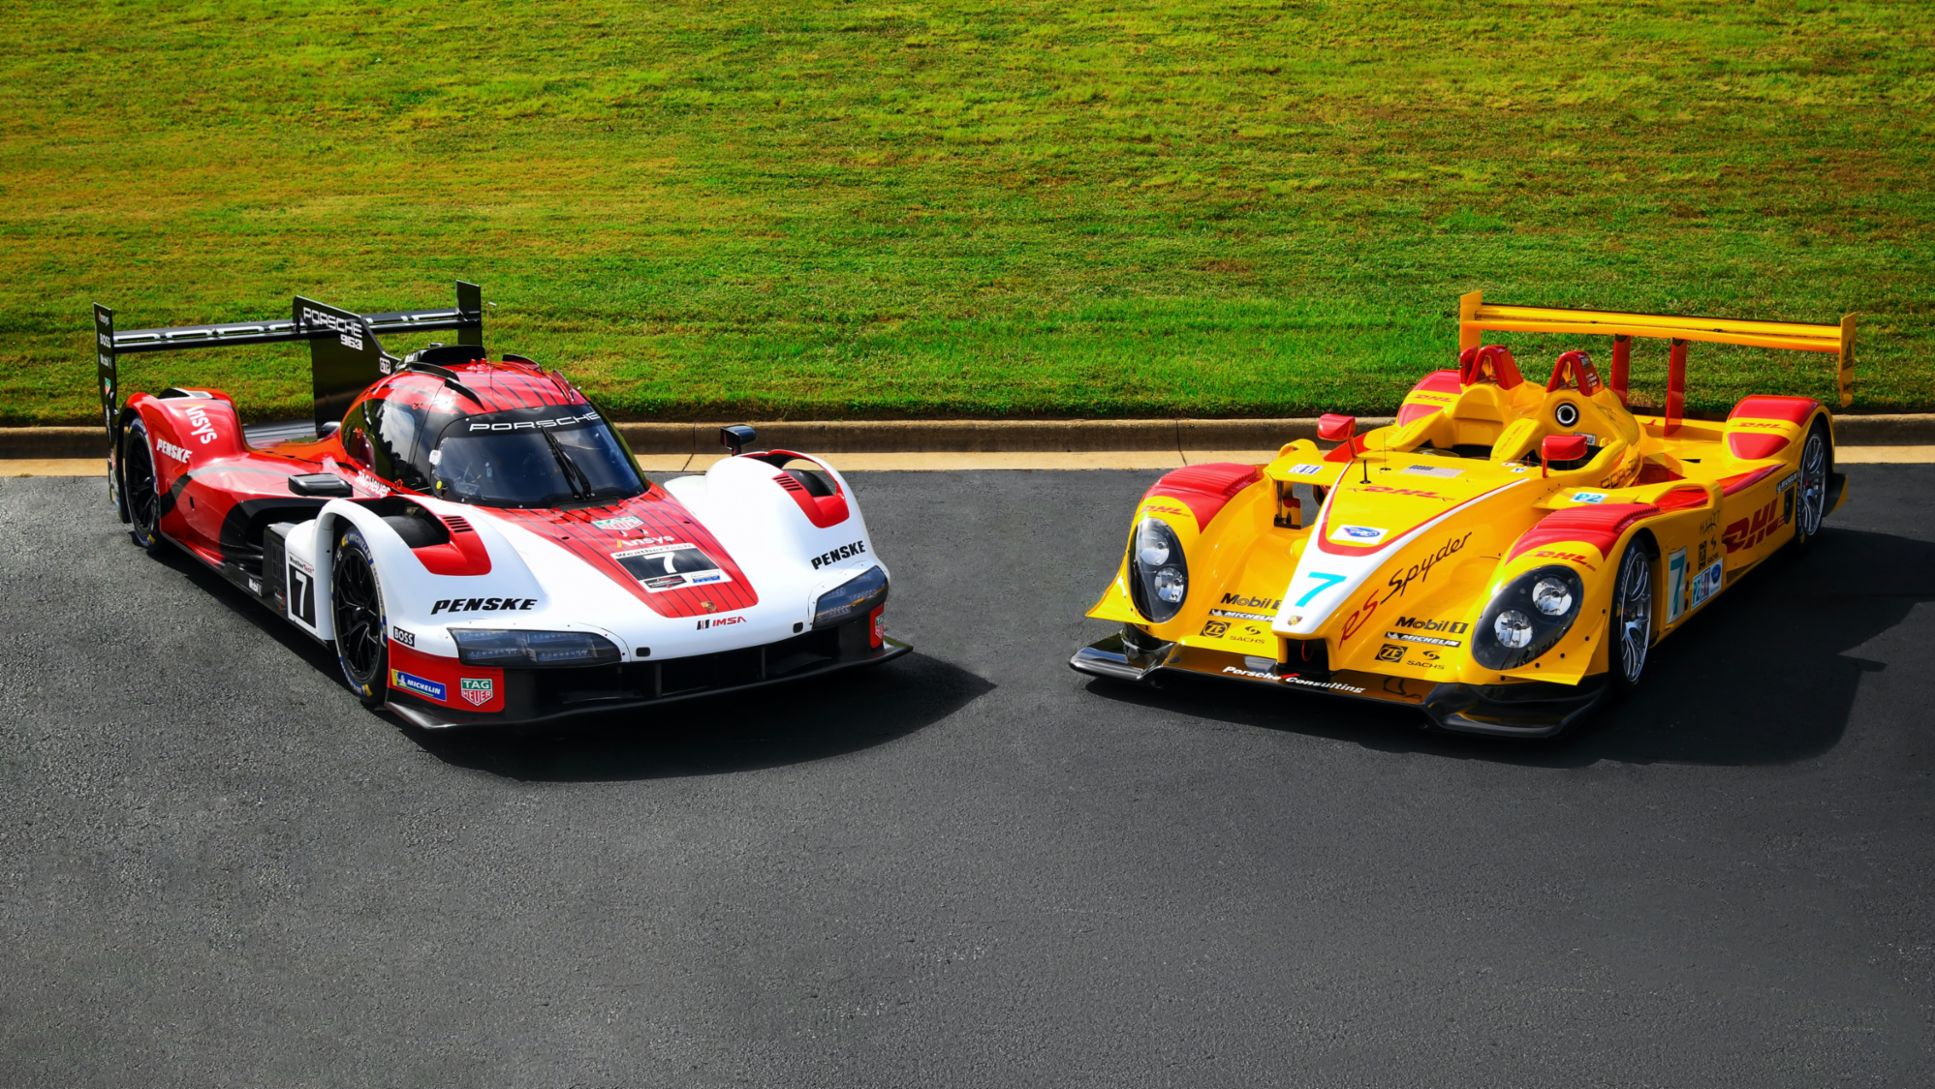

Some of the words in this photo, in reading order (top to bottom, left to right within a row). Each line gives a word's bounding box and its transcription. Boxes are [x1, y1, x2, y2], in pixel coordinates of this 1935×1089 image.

[303, 306, 363, 338] PORSCHE
[340, 333, 363, 351] 963
[469, 411, 601, 432] PORSCHE
[156, 438, 193, 464] PENSKE
[1363, 485, 1441, 499] DHL
[1574, 493, 1603, 503] P2
[1721, 498, 1779, 554] DHL
[616, 535, 675, 548] Ansys
[643, 551, 677, 574] 7
[811, 540, 866, 570] PENSKE
[1535, 551, 1588, 566] DHL
[295, 570, 307, 618] 7
[1294, 571, 1347, 608] 7
[1338, 588, 1379, 650] RS
[1380, 531, 1472, 605] Spyder
[1669, 554, 1685, 616] 7
[431, 597, 538, 615] PENSKE
[1220, 592, 1272, 609] Mobil
[712, 615, 747, 627] IMSA
[1204, 624, 1226, 634] ZF
[1395, 616, 1449, 632] Mobil
[1449, 622, 1469, 634] 1
[394, 627, 414, 645] BOSS
[1229, 635, 1265, 645] SACHS
[1400, 634, 1460, 647] MICHELIN
[1380, 649, 1403, 658] ZF
[1406, 660, 1445, 670] SACHS
[406, 680, 441, 695] MICHELIN
[463, 680, 490, 689] TAG
[1222, 665, 1282, 681] Porsche
[1285, 676, 1366, 694] Consulting
[462, 690, 491, 704] HEUER
